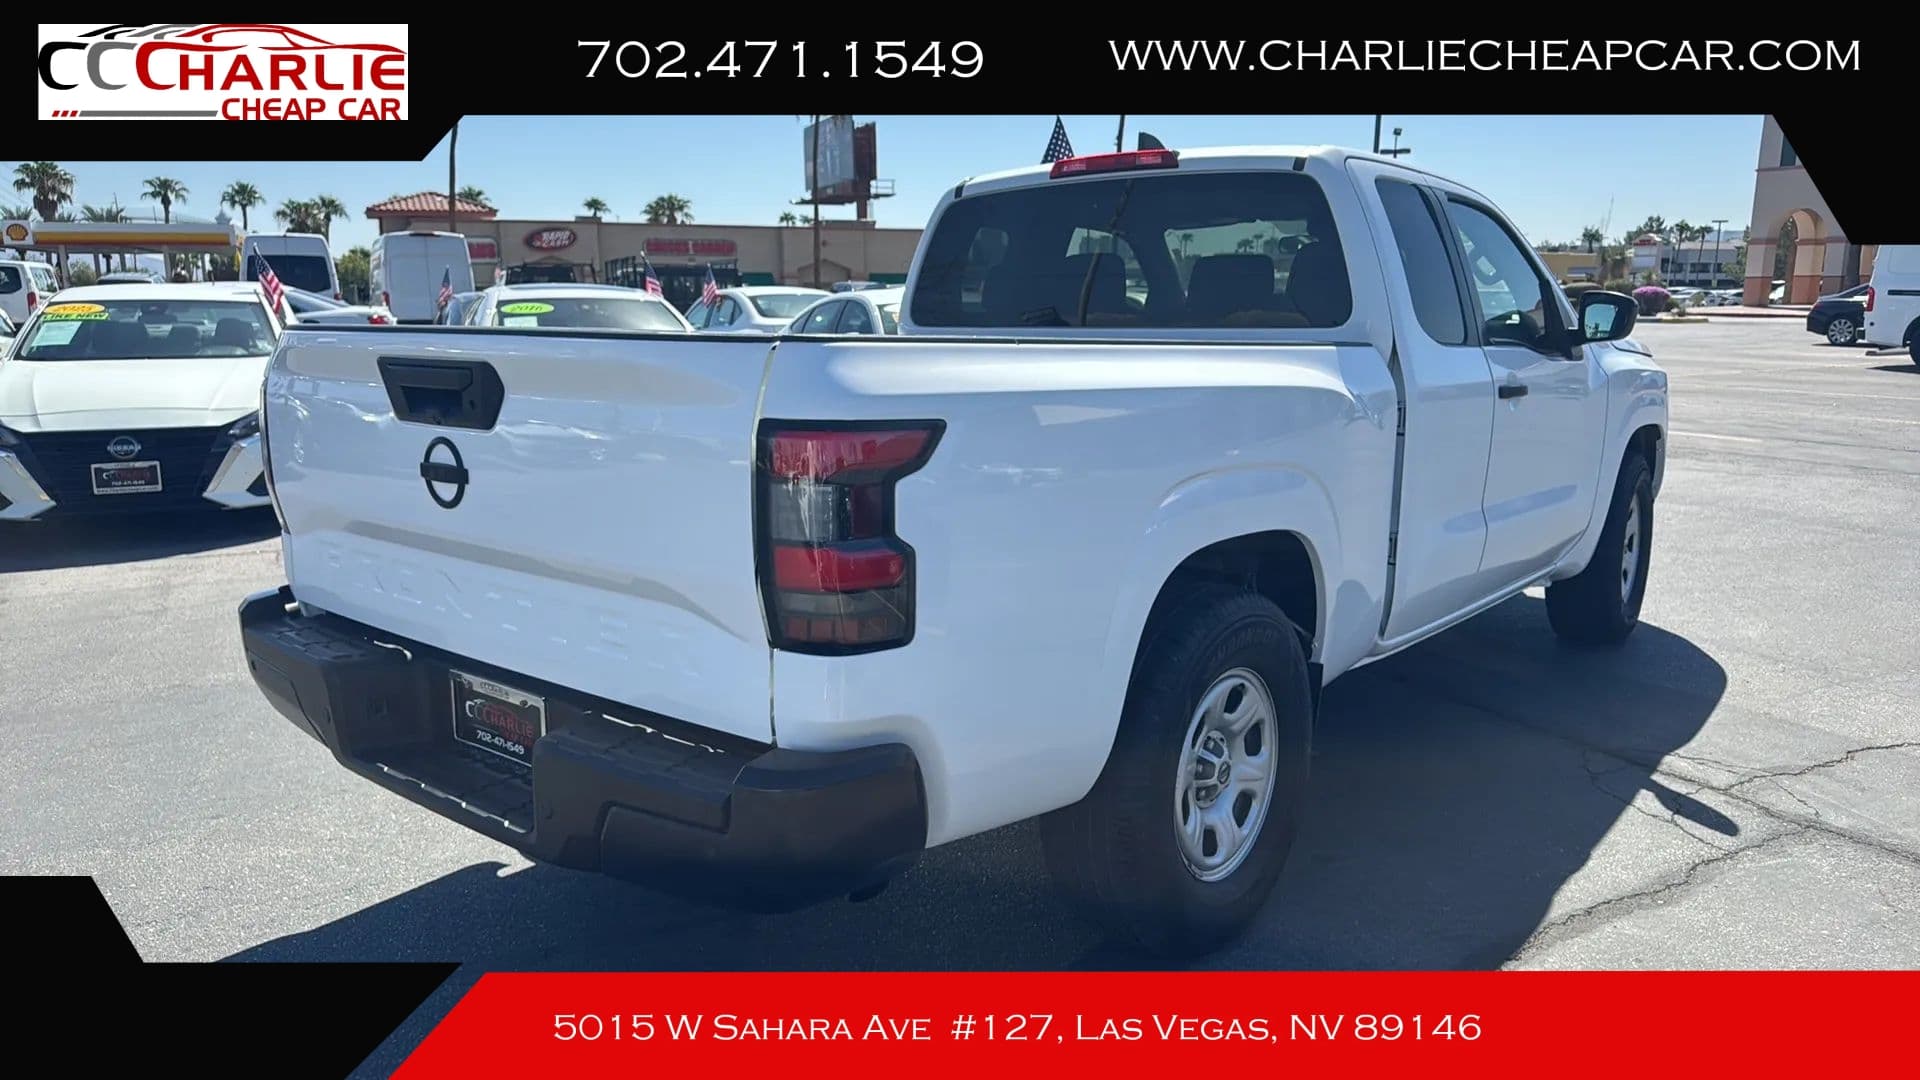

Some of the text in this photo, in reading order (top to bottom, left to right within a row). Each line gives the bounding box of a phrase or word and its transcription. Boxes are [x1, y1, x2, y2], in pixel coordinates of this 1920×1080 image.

[542, 230, 571, 241] RAPID
[542, 240, 569, 249] CASH
[476, 729, 525, 755] 702-471-1549
